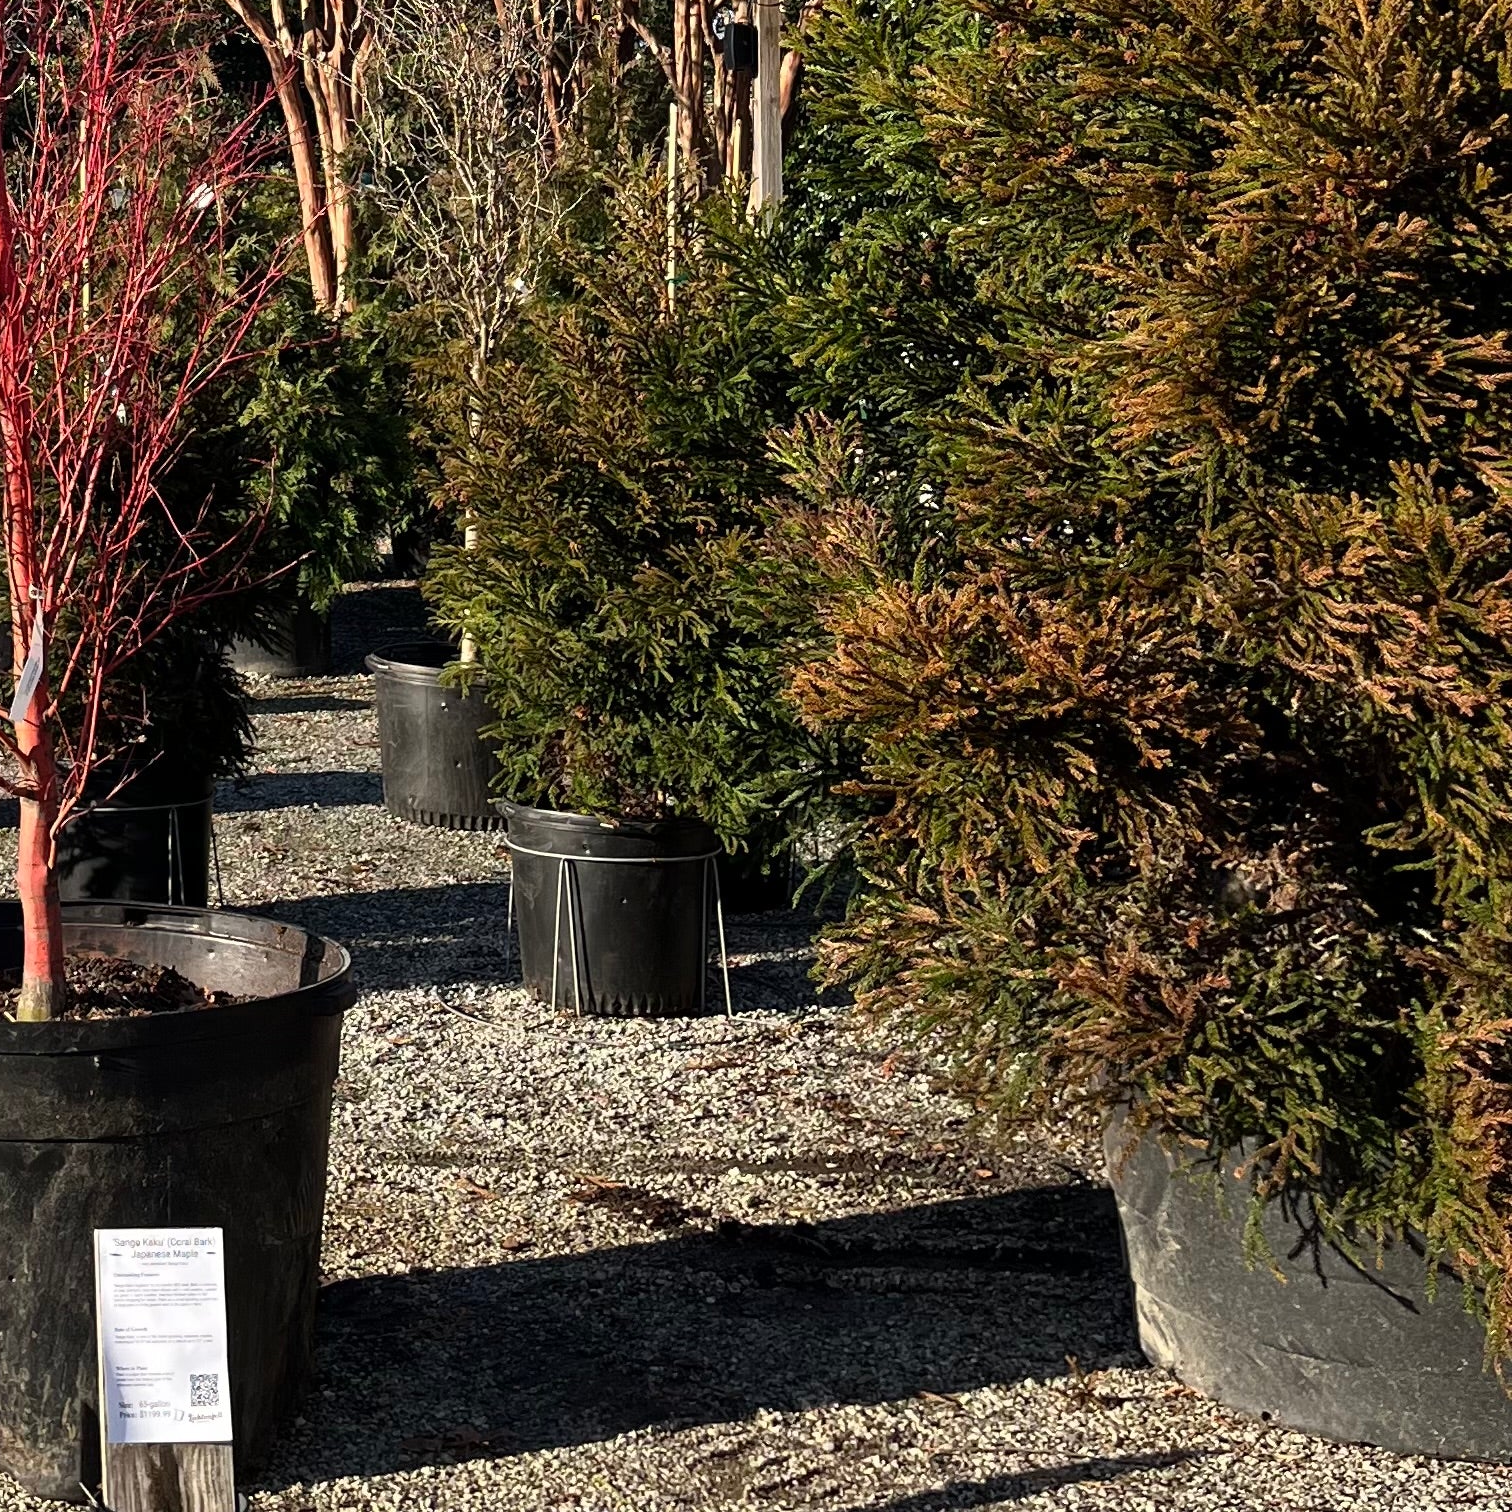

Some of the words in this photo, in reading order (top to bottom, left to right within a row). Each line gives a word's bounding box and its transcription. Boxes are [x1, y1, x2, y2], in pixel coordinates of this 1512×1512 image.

[168, 1238, 191, 1248] (Coral
[194, 1237, 216, 1248] Bark)
[131, 1250, 171, 1259] Japanese
[173, 1250, 199, 1259] Maple
